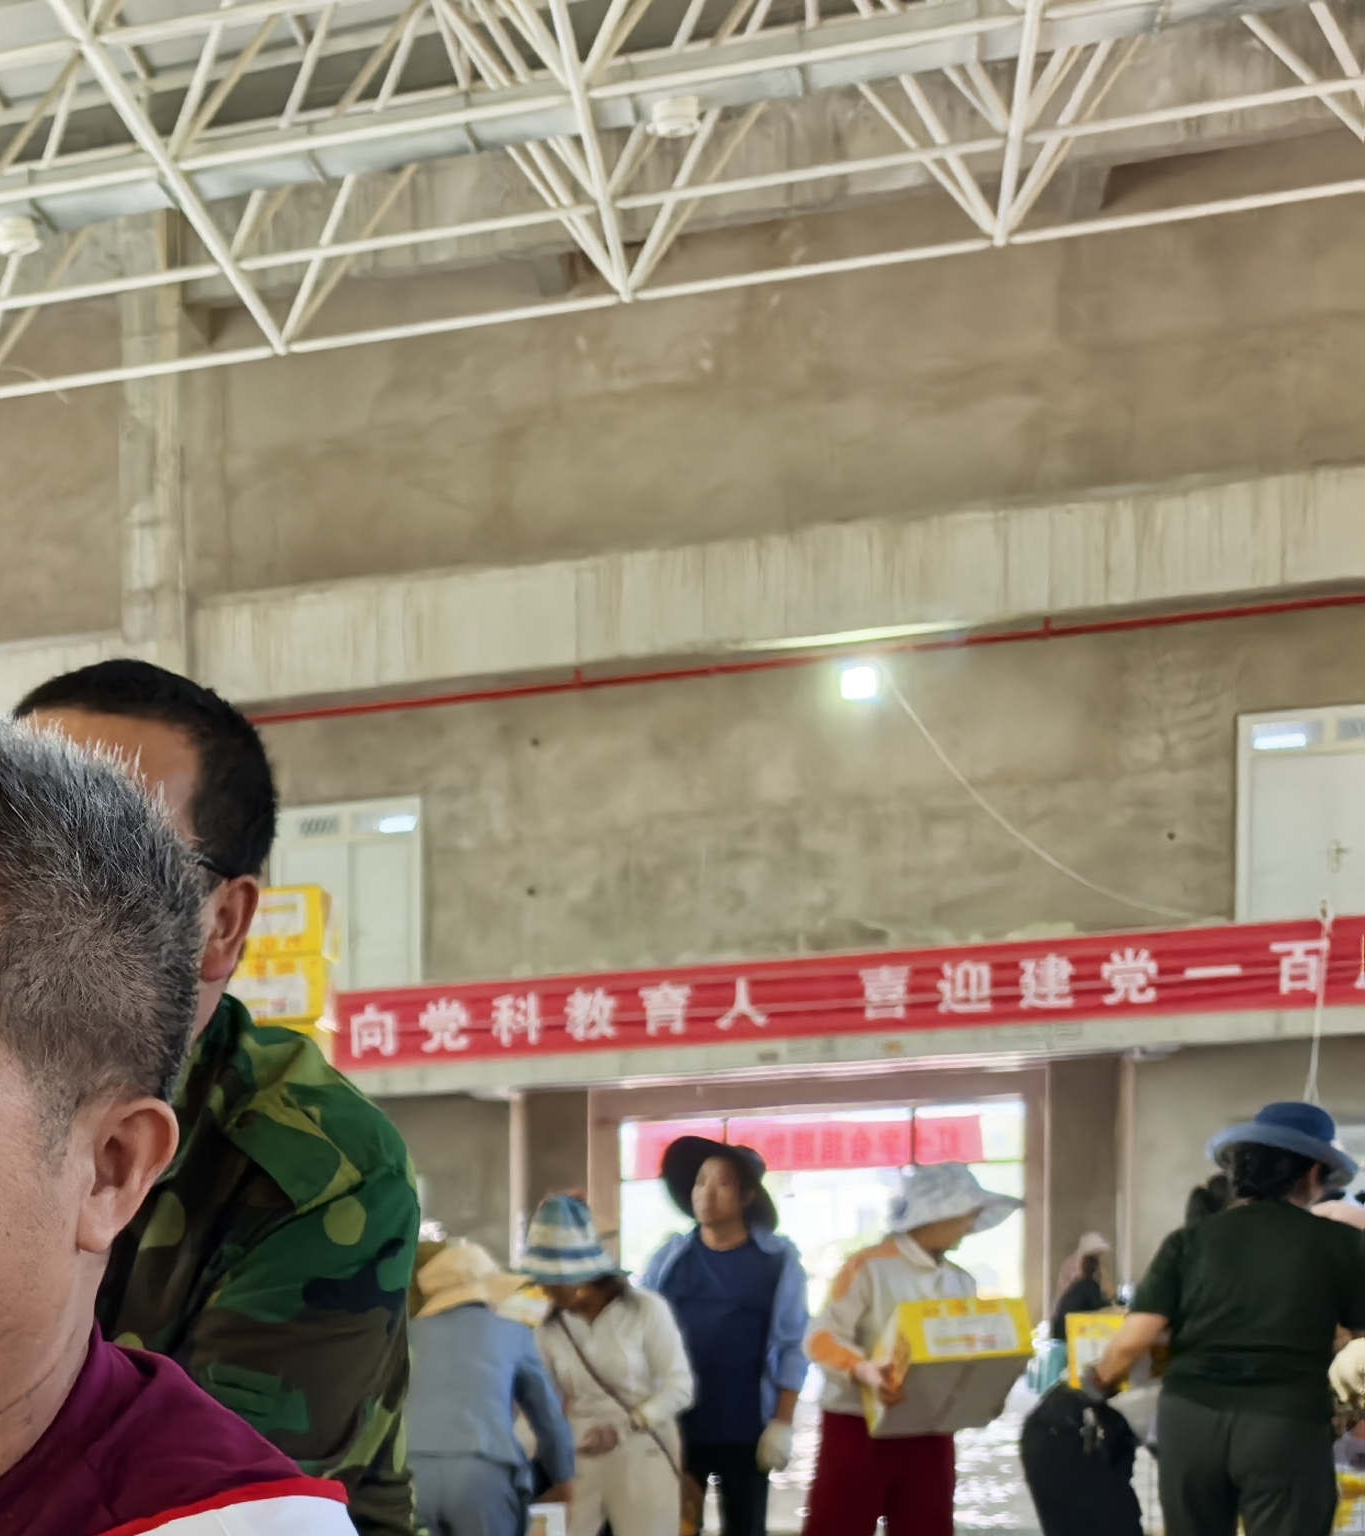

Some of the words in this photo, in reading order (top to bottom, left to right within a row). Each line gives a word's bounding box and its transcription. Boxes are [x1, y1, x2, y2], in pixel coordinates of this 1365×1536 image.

[349, 975, 769, 1058] 向党科教育人
[857, 938, 1365, 1022] 喜迎建党一百
